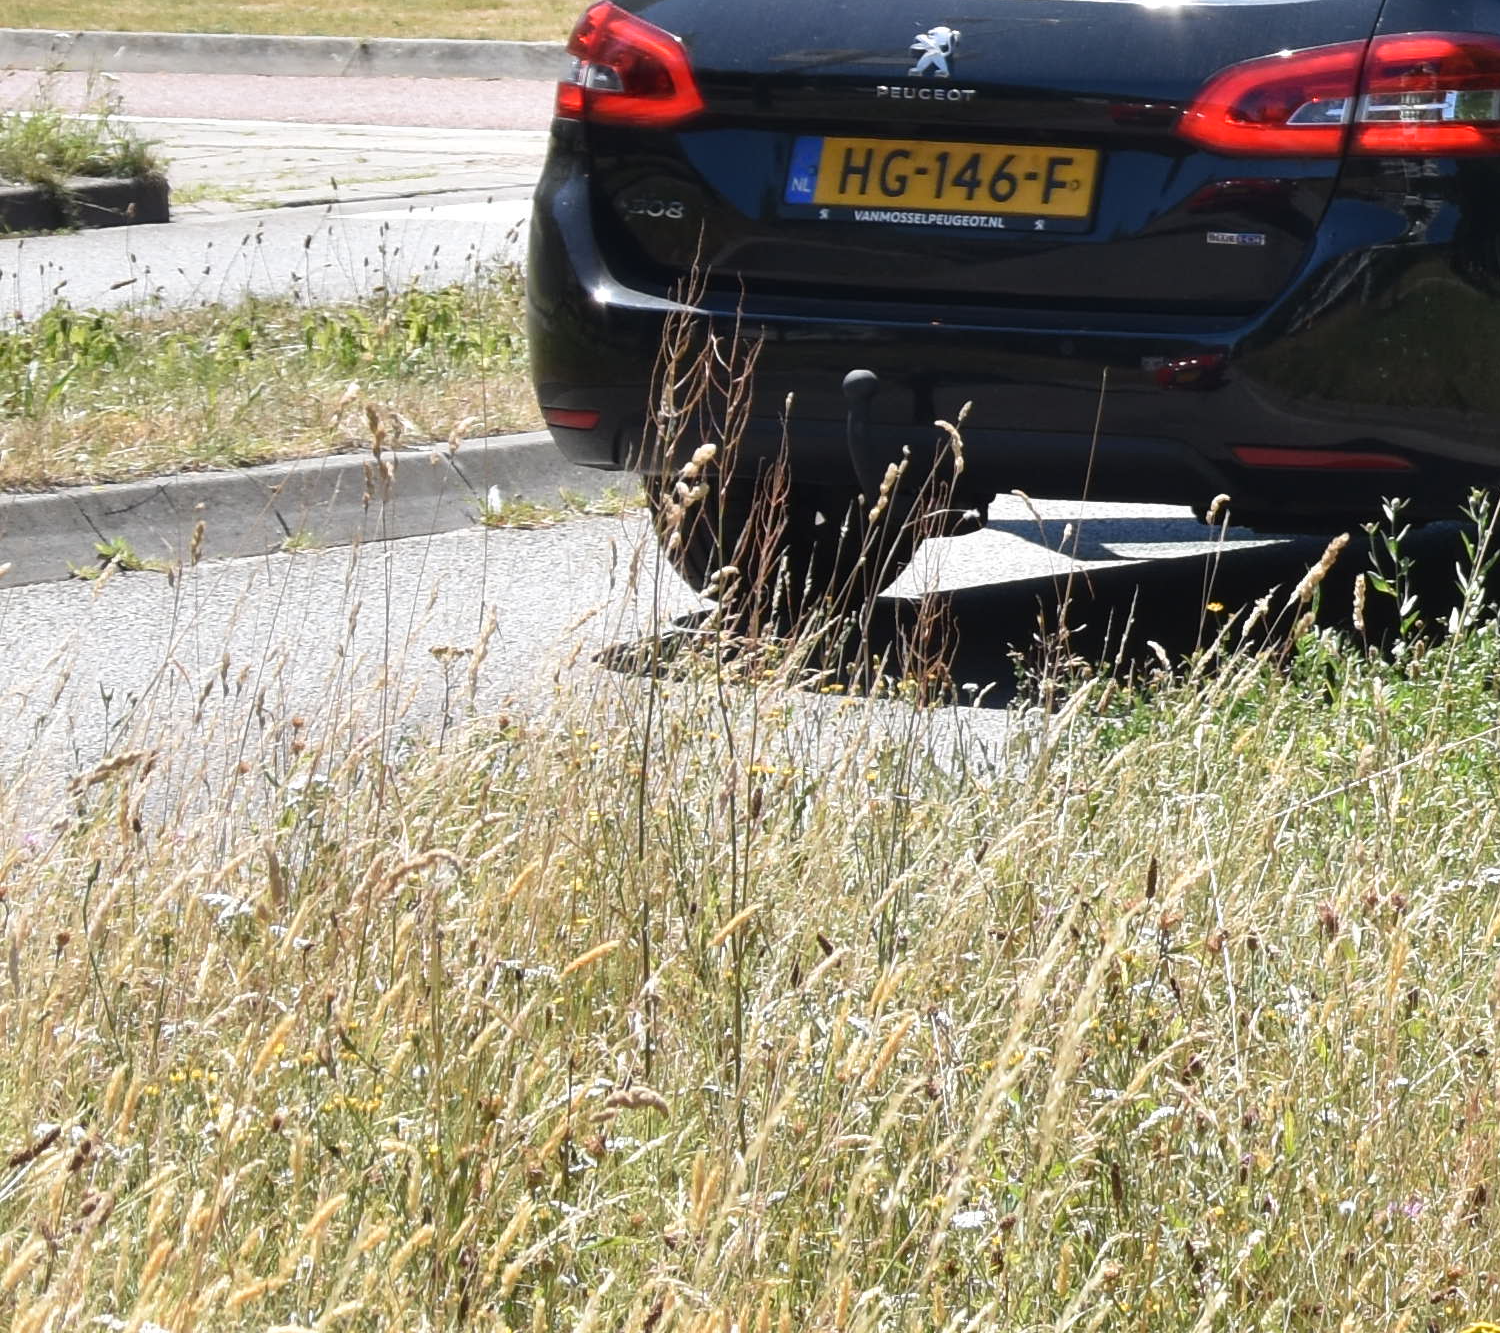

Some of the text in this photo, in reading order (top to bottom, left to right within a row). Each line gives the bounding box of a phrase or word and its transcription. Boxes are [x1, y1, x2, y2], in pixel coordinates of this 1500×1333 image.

[875, 85, 977, 101] PEUGEOT
[791, 146, 1074, 205] NL HG-146-F
[853, 208, 1006, 230] VANMOSSELPEUGEOT.NL
